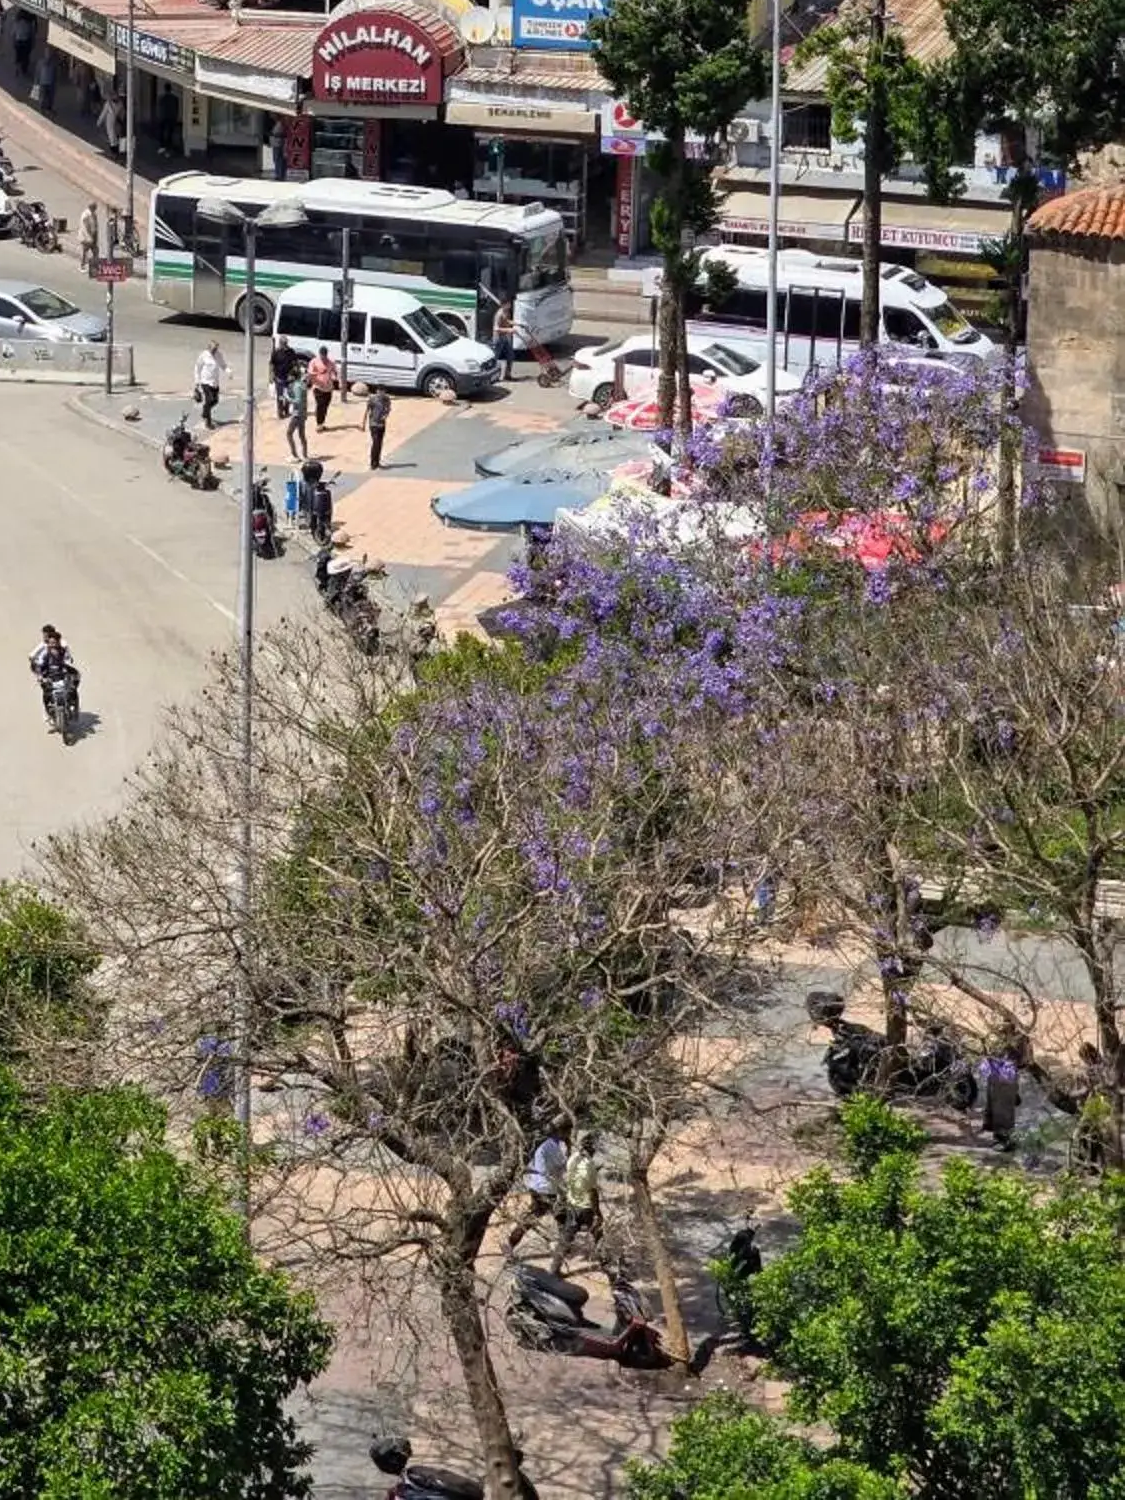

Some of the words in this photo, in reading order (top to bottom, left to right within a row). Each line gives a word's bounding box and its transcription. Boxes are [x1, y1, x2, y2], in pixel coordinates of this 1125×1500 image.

[318, 25, 431, 66] HİLALHAN
[324, 71, 342, 92] İŞ
[346, 76, 426, 93] MERKEZİ
